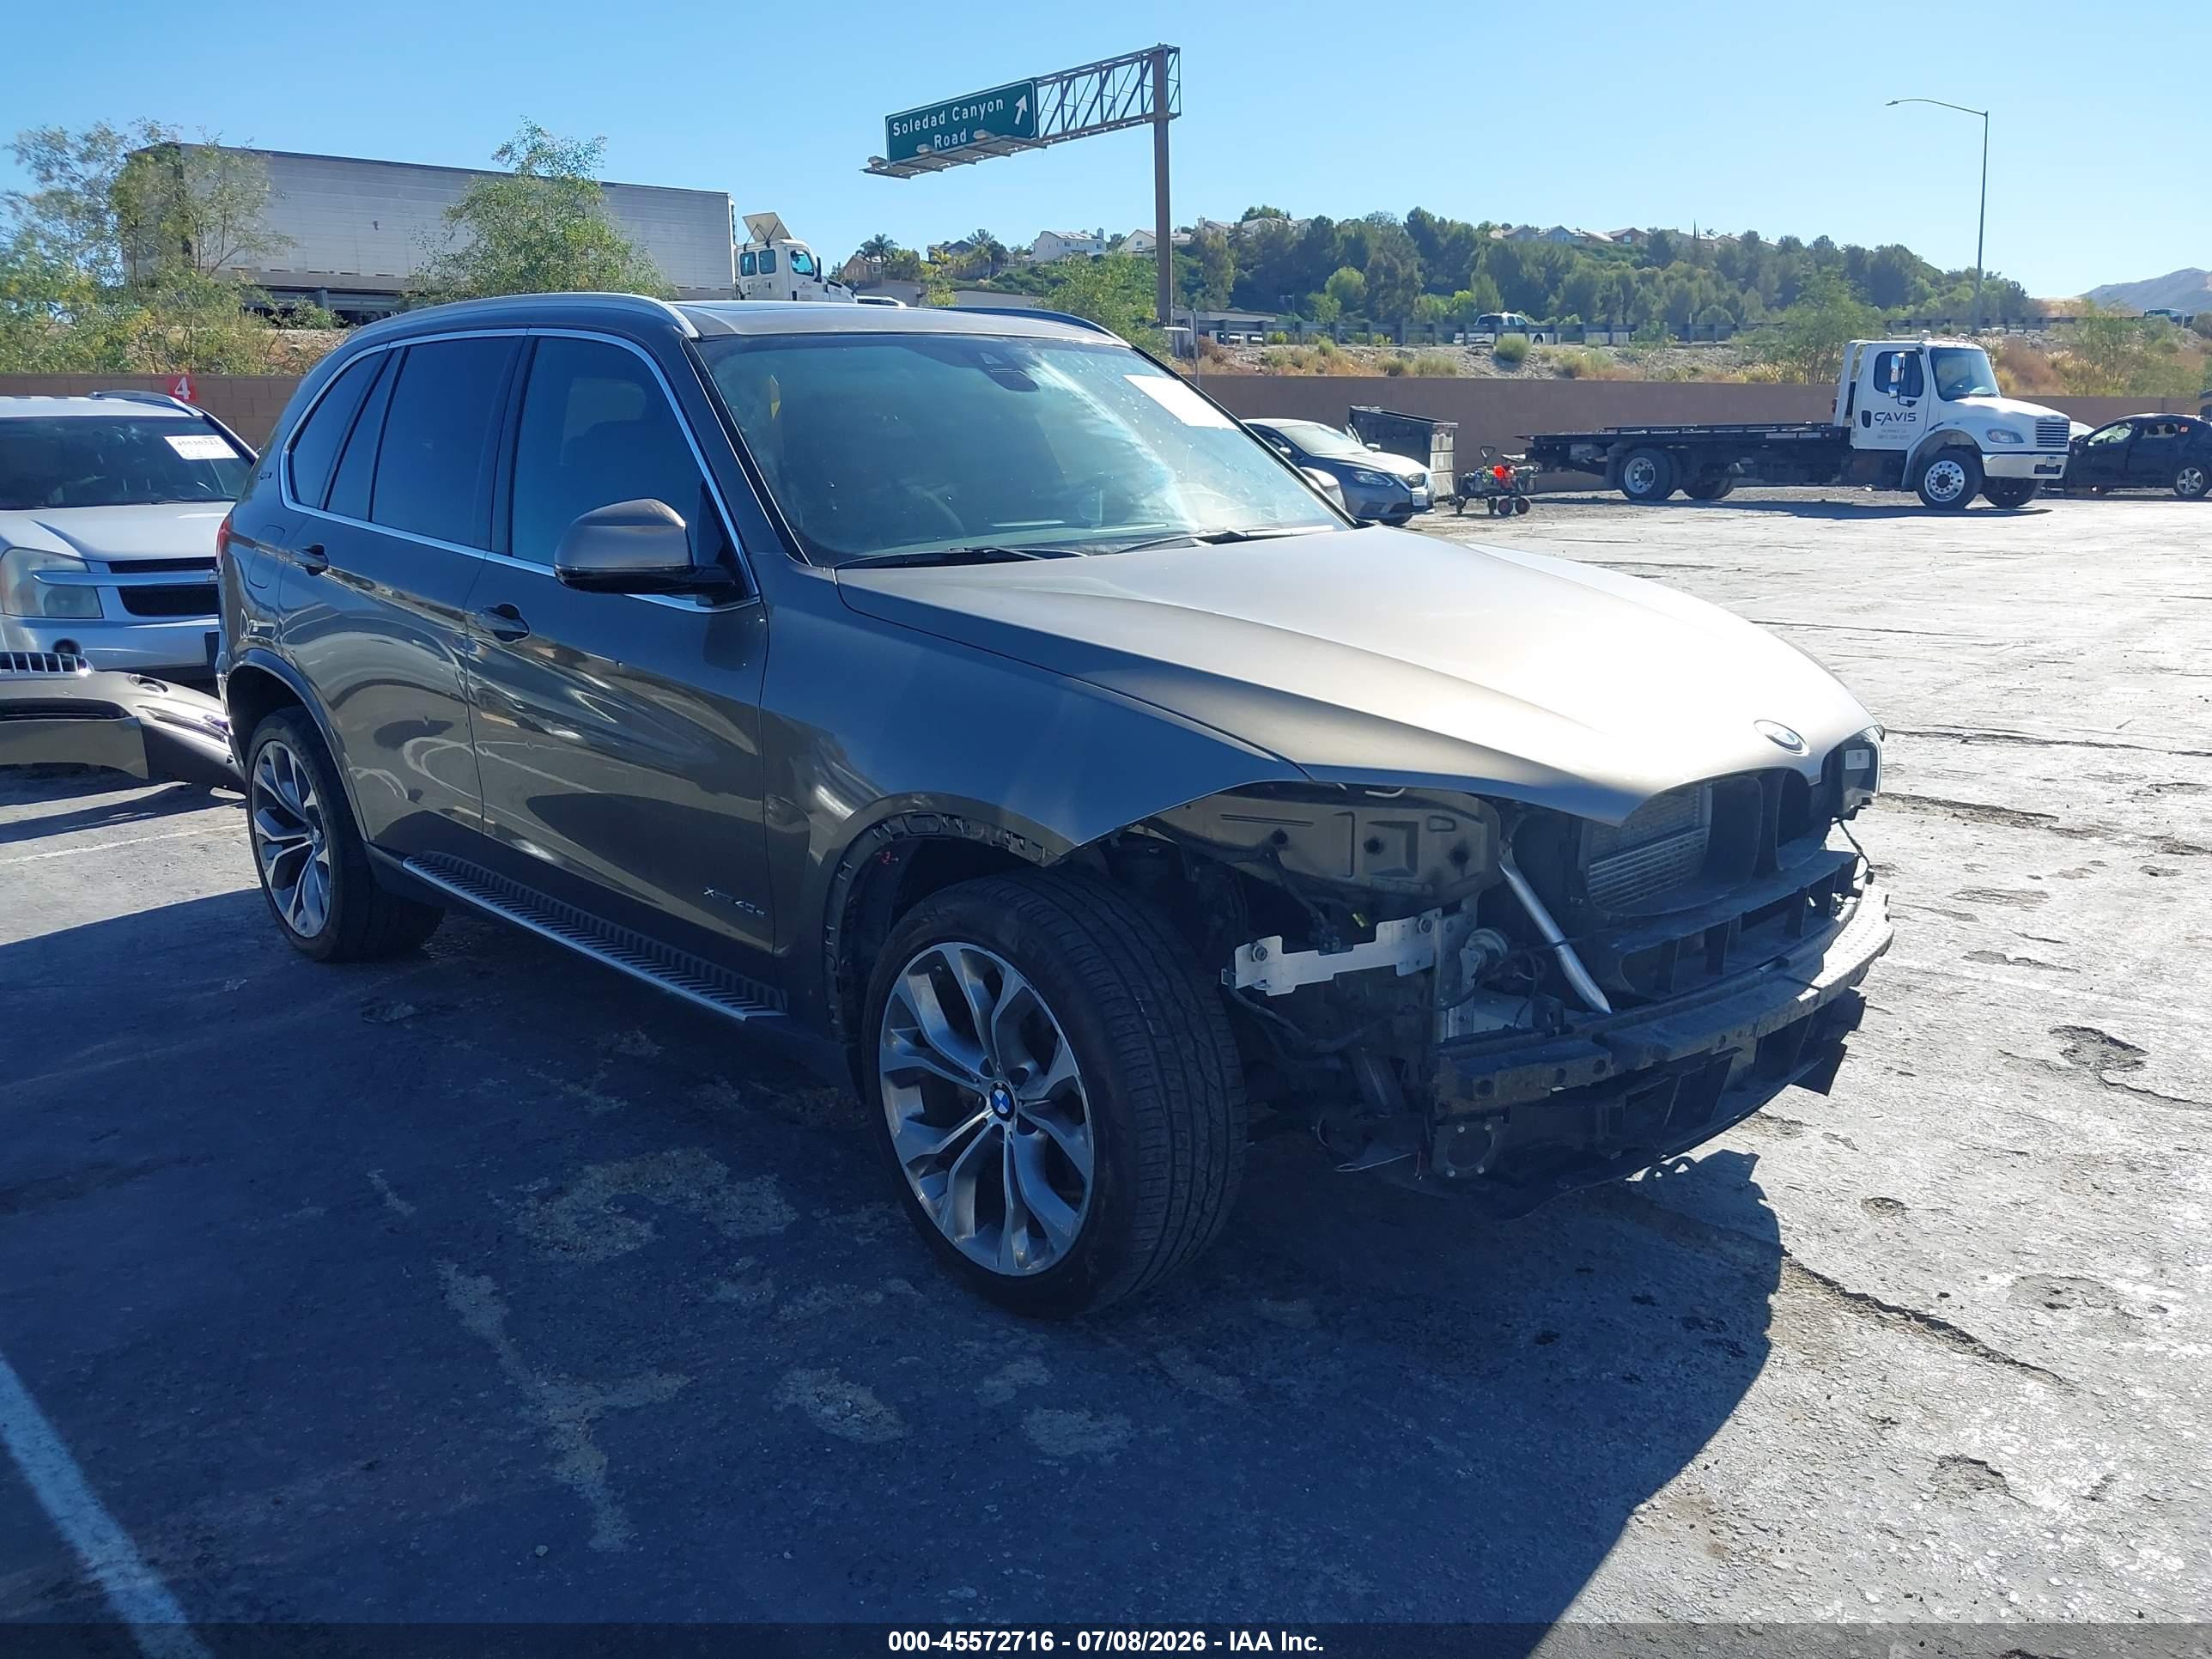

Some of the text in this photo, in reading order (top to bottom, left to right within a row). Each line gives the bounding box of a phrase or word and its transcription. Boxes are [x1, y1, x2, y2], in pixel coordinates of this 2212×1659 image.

[893, 99, 1004, 137] Soledad Canyon
[933, 128, 967, 149] Road
[174, 376, 191, 400] 4
[1875, 412, 1917, 426] CAVIS
